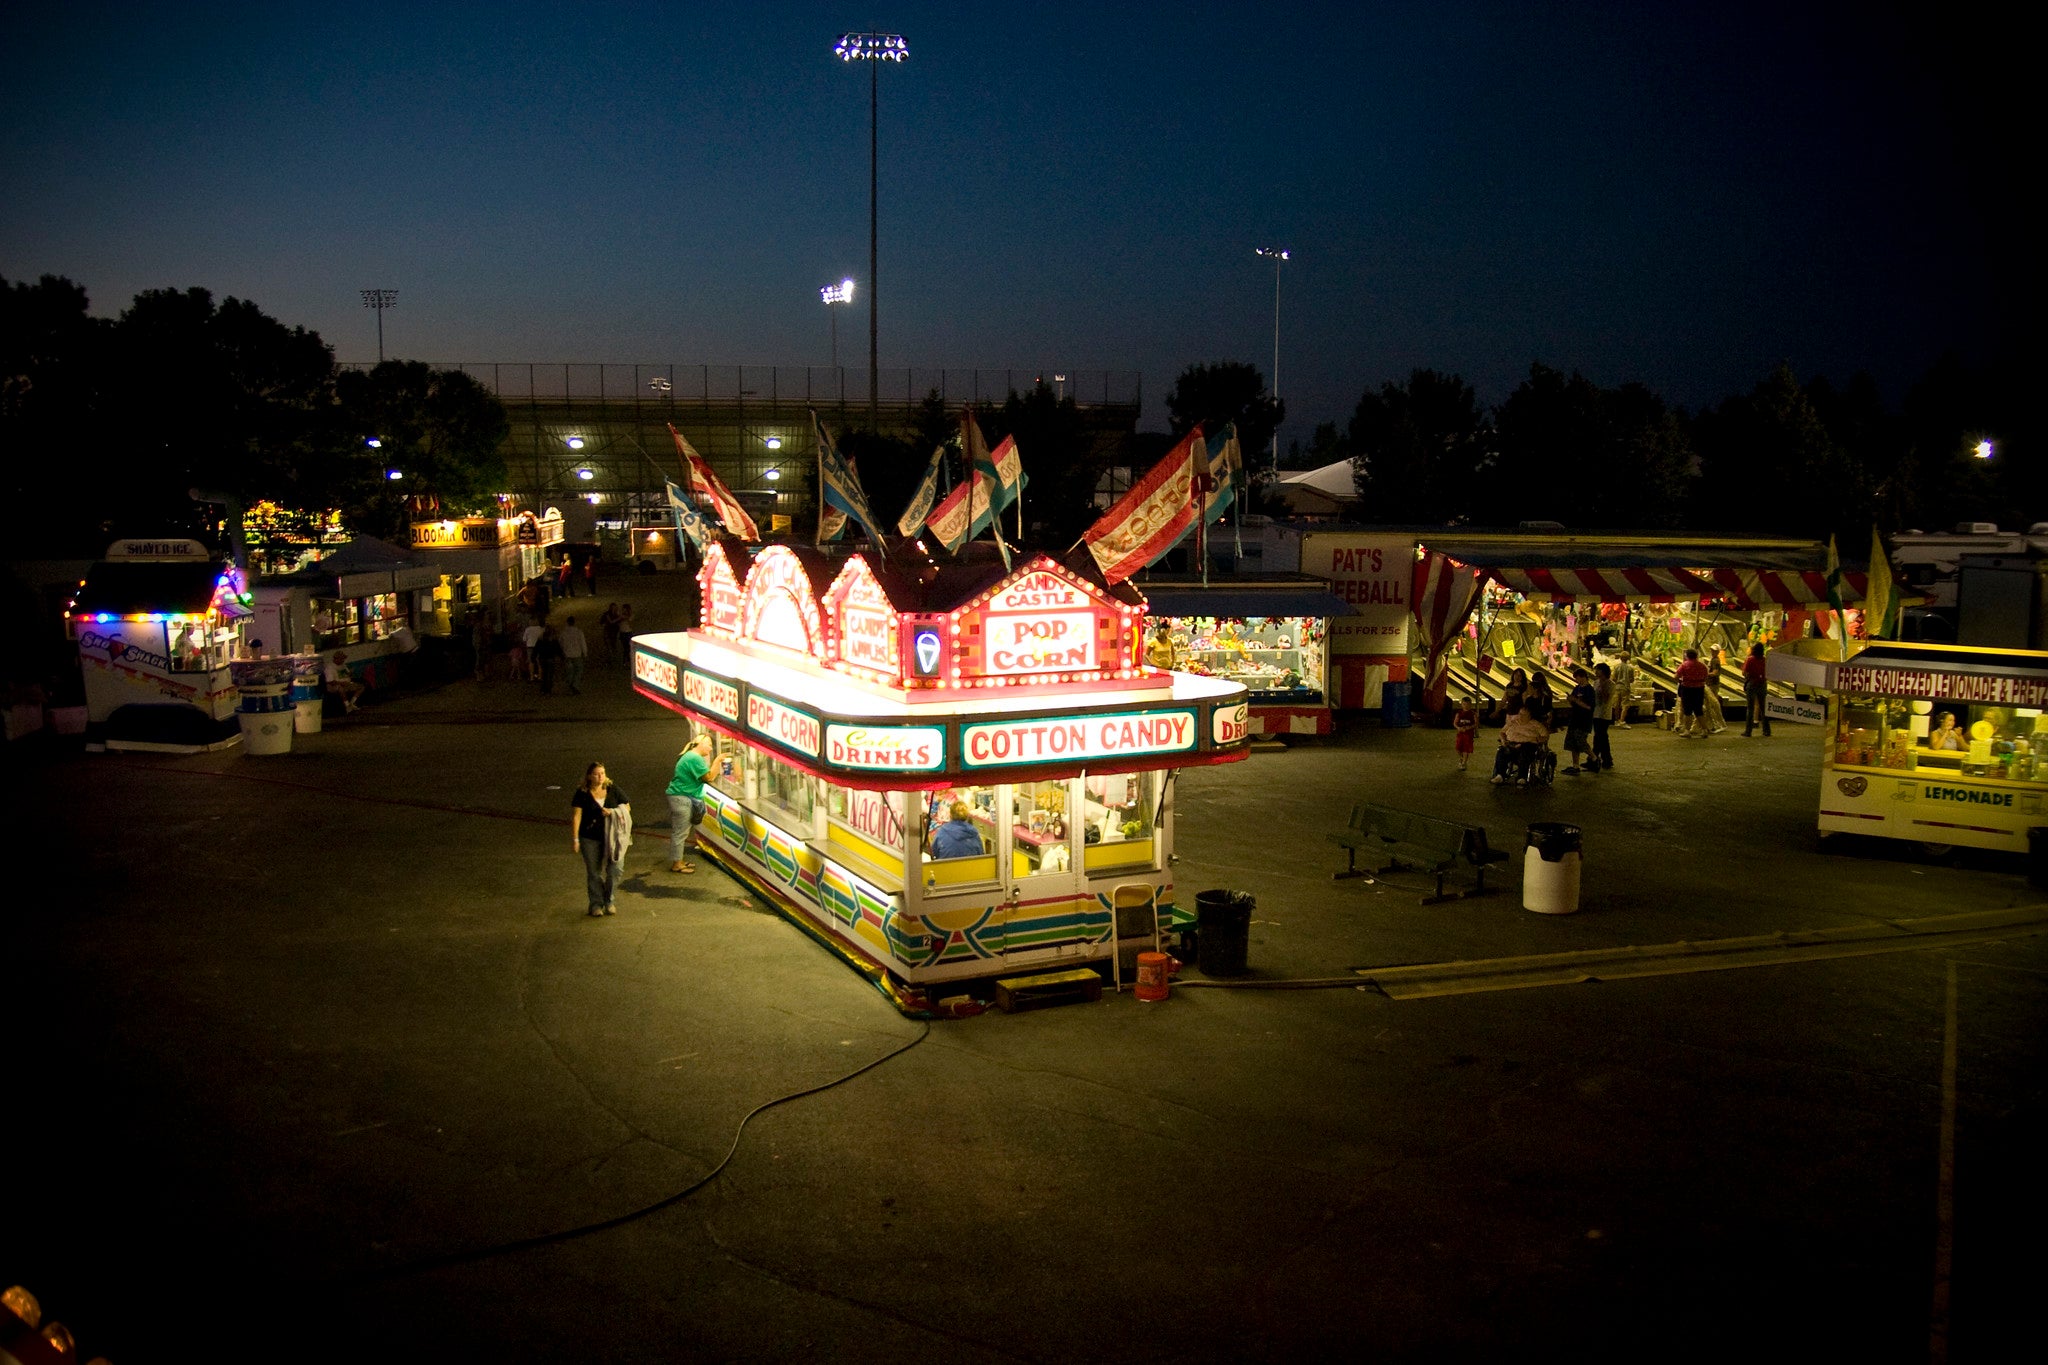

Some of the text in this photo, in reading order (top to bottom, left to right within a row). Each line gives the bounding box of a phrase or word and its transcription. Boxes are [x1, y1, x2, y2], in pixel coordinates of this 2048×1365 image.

[127, 543, 191, 554] SHAVED ICE
[1332, 548, 1383, 572] PAT'S
[1014, 573, 1065, 592] CANDY
[1005, 592, 1074, 607] CASTLE
[1013, 620, 1067, 645] POP
[1355, 626, 1378, 635] FOR
[993, 643, 1088, 670] CORN
[636, 655, 677, 690] SNO-CONES
[685, 675, 739, 717] CANDY APPLES
[1838, 667, 1872, 692] FRESH
[1874, 670, 1932, 696] SQUEEZED
[1934, 674, 1997, 701] LEMONADE
[2000, 679, 2008, 703] &
[1768, 701, 1822, 720] Funnel Cakes
[750, 698, 819, 752] POP CORN
[846, 730, 907, 748] Cold
[971, 716, 1188, 760] COTTON CANDY
[833, 740, 930, 765] DRINKS
[1925, 786, 2013, 806] LEMONADE
